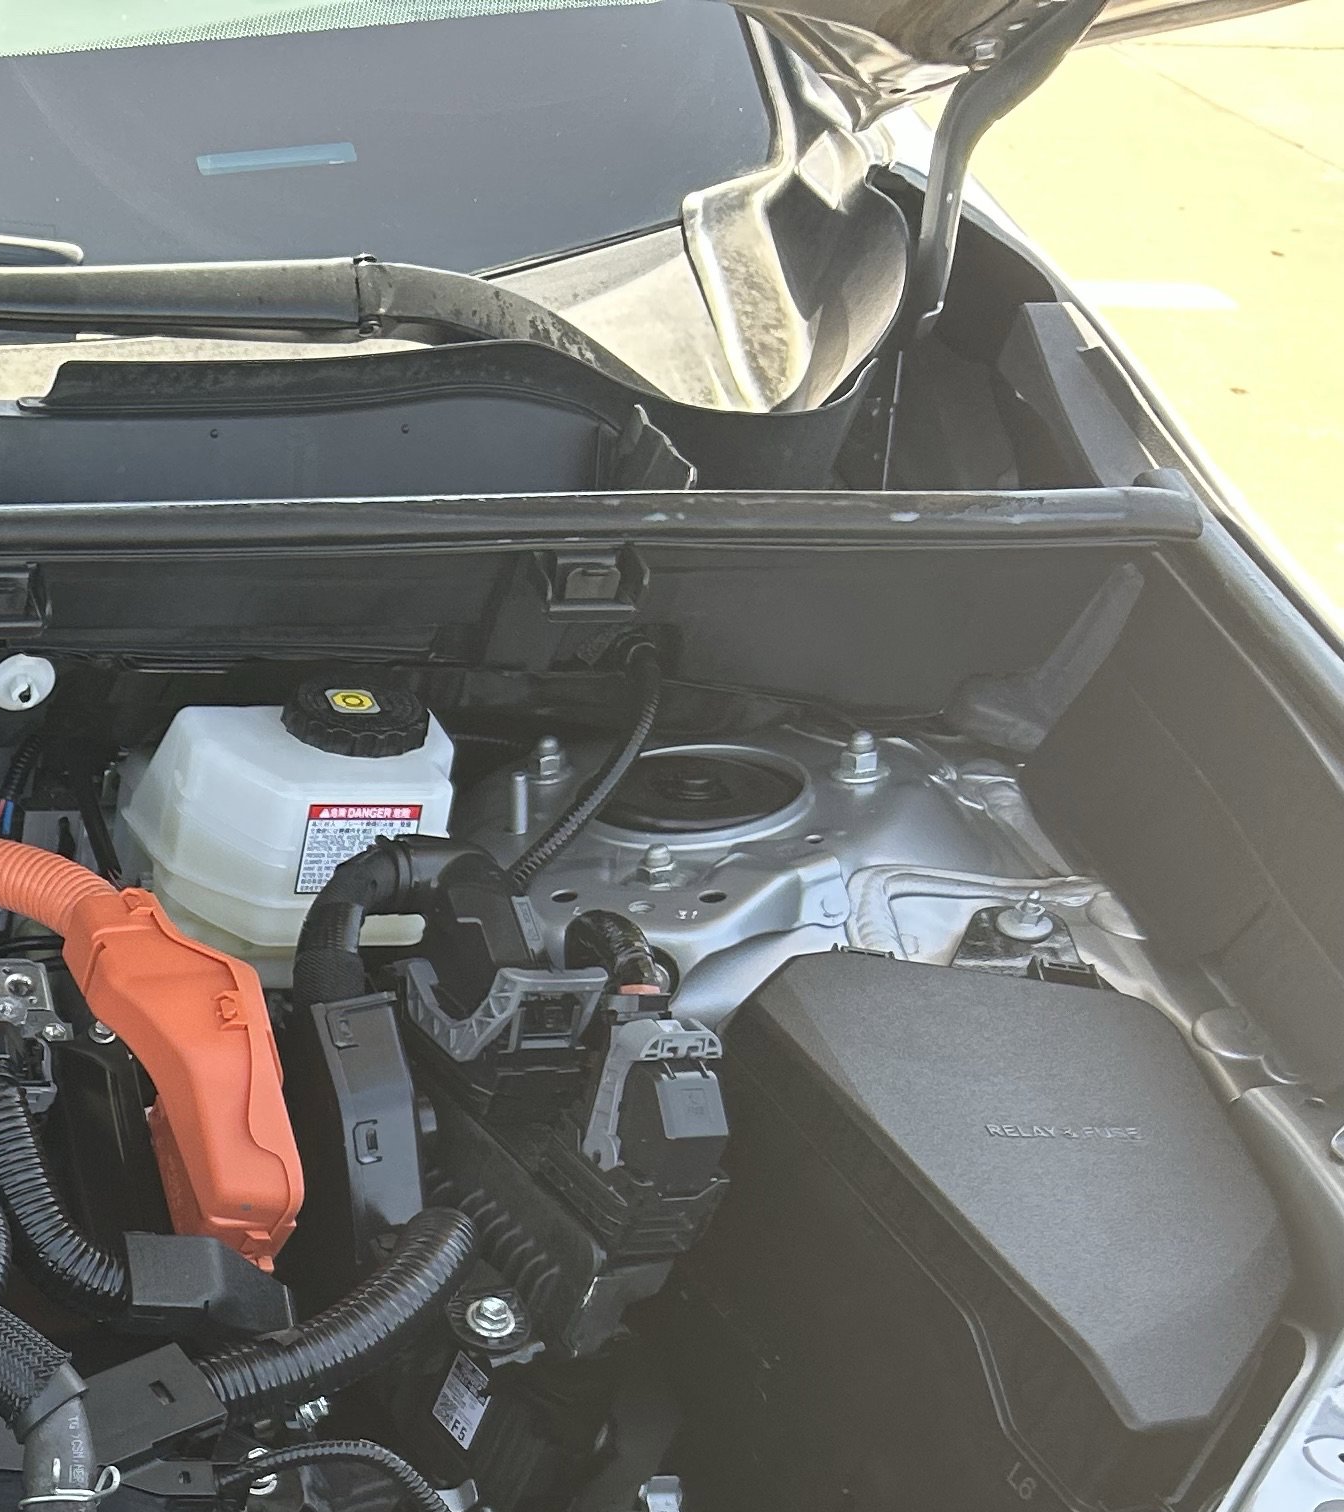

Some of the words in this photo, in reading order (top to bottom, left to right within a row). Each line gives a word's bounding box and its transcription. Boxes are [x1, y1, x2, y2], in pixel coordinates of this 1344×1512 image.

[348, 807, 391, 818] DANGER
[985, 1123, 1056, 1139] RELAY
[1062, 1127, 1079, 1139] &
[1082, 1126, 1142, 1140] FUSE
